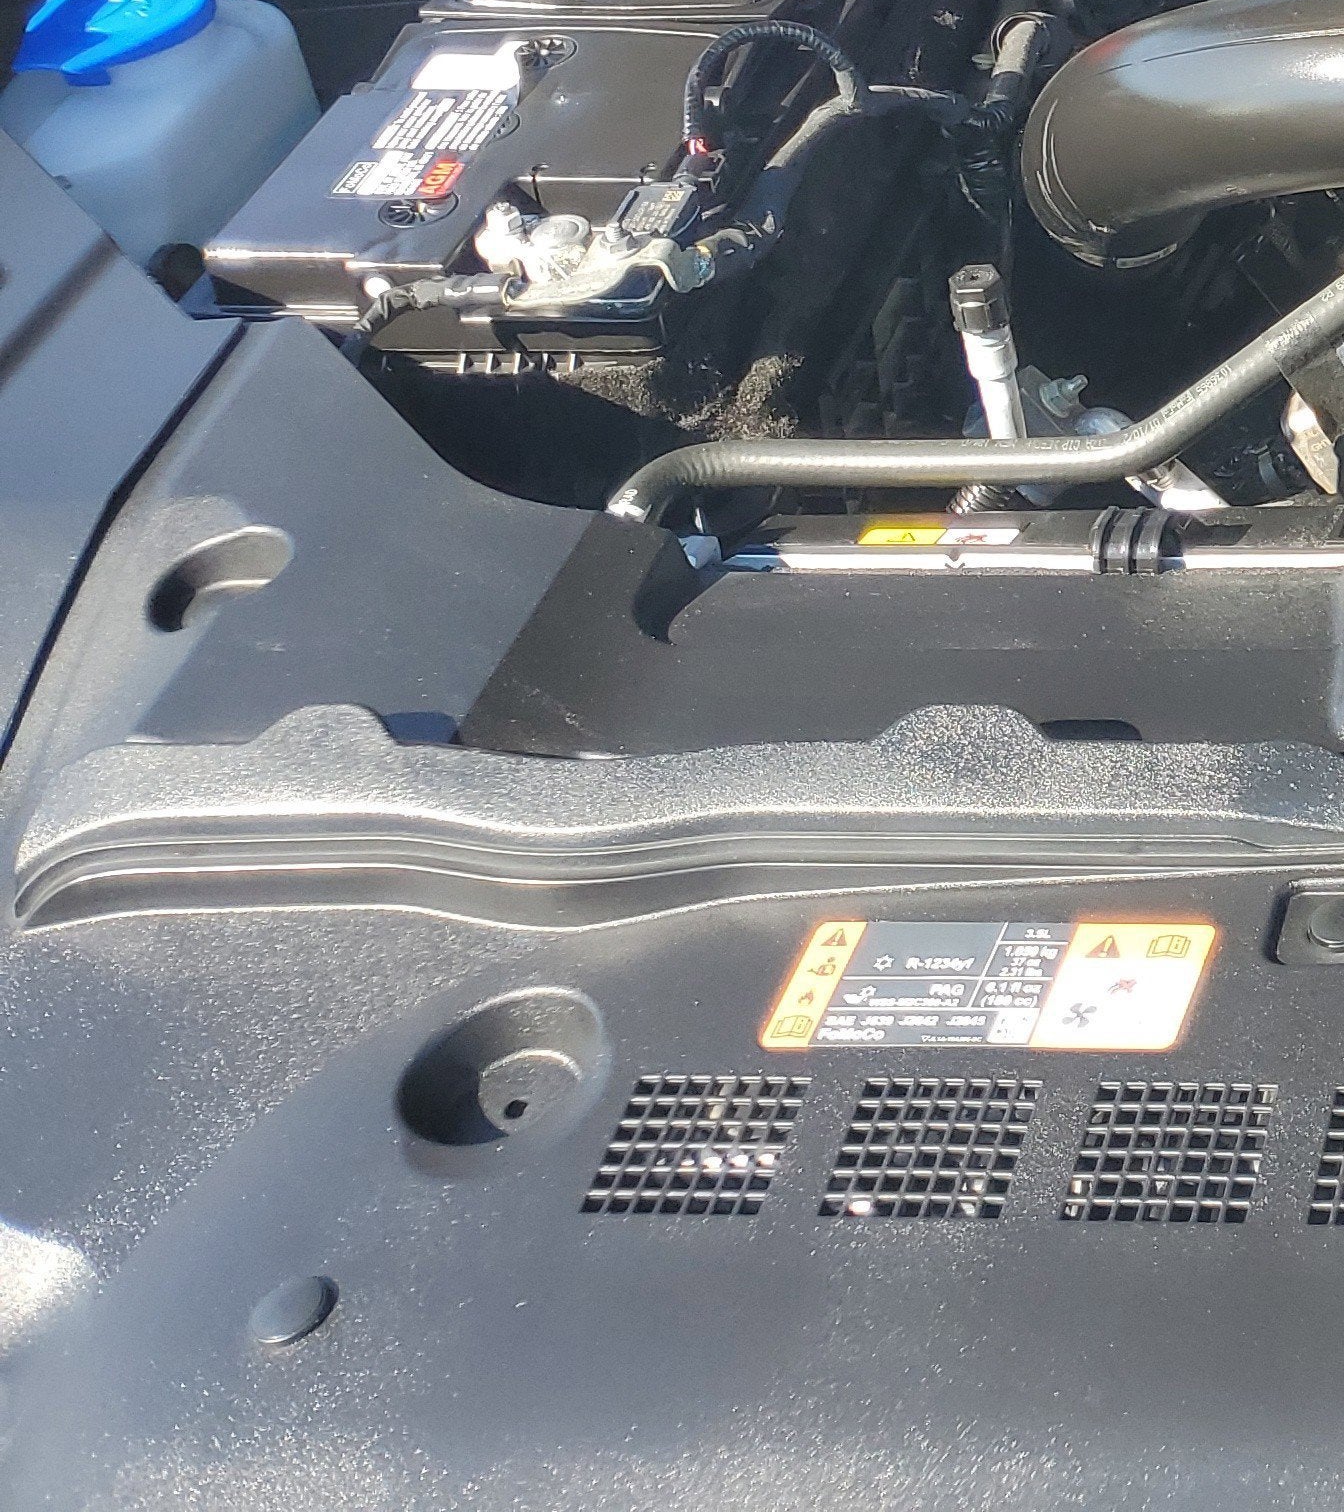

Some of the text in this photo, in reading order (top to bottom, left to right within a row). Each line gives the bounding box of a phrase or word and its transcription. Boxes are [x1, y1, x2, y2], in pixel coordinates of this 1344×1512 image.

[416, 163, 456, 194] AGM
[929, 983, 965, 996] PAG
[816, 1027, 886, 1041] FoMoCo
